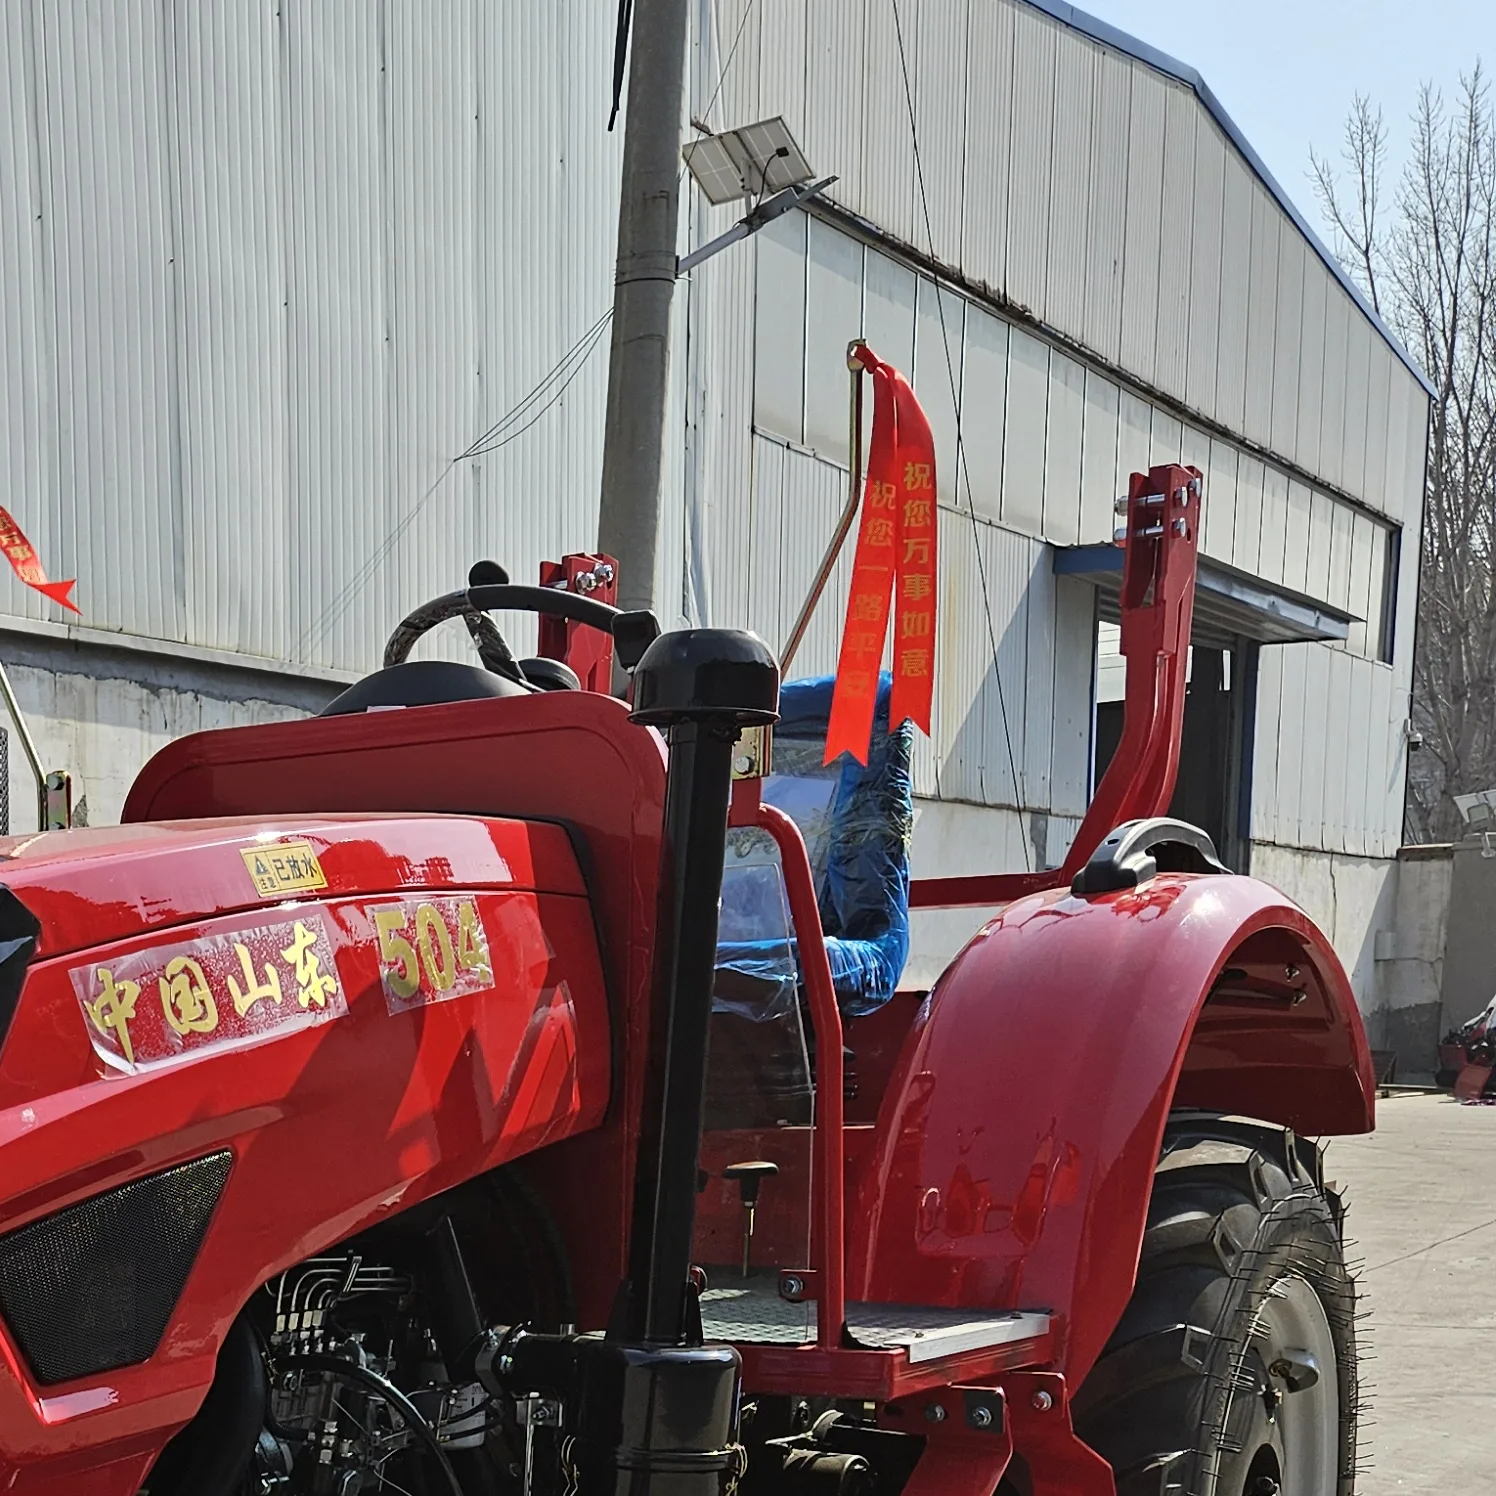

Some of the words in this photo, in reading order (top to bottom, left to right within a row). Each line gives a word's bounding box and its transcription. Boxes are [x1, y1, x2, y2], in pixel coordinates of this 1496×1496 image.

[842, 479, 897, 699] 祝您一路平安
[900, 461, 932, 677] 祝您万事如意
[272, 853, 318, 881] 已放水
[85, 920, 338, 1064] 中国山东
[374, 902, 491, 998] 504
